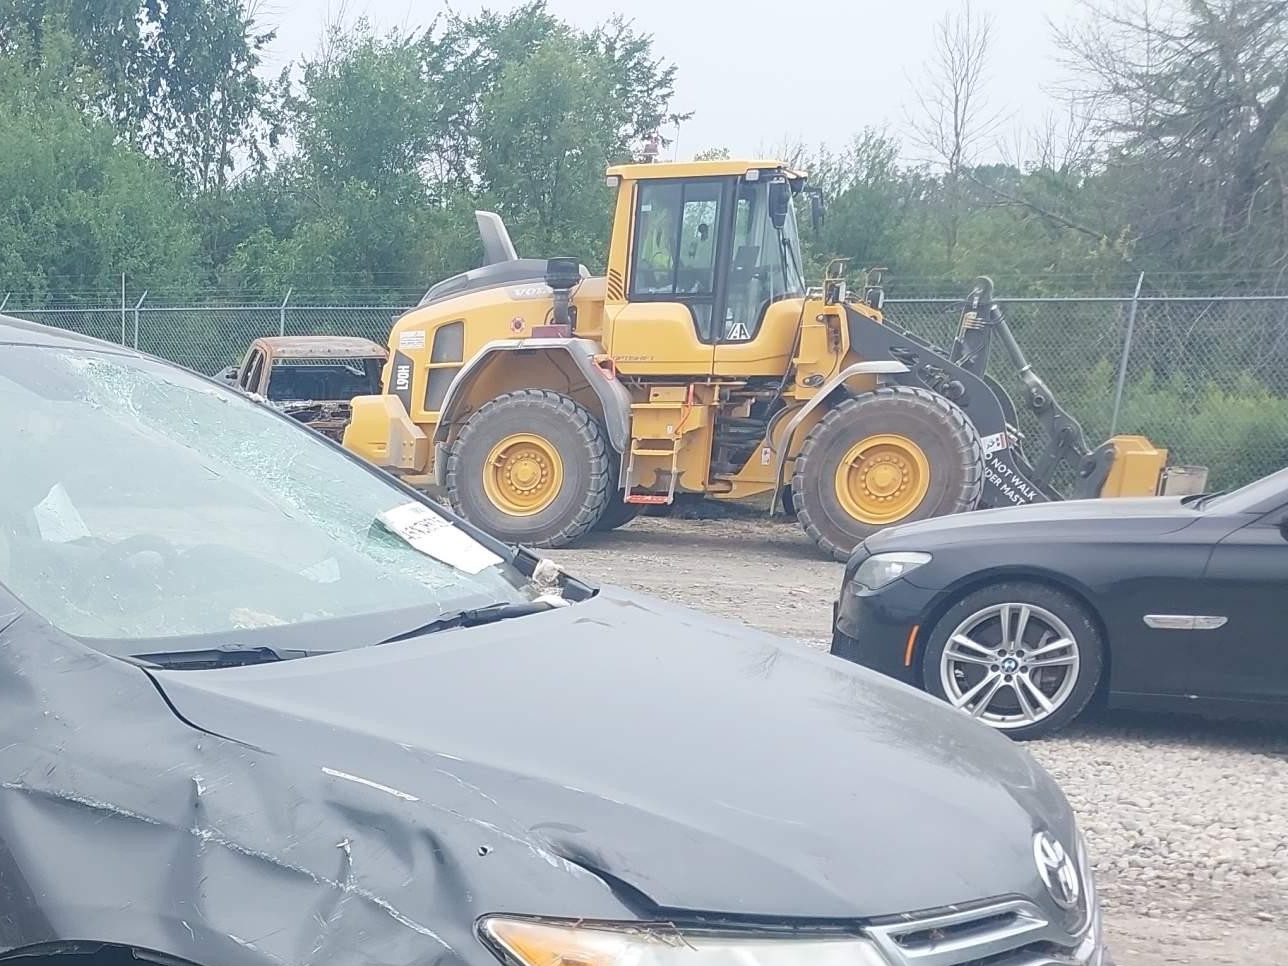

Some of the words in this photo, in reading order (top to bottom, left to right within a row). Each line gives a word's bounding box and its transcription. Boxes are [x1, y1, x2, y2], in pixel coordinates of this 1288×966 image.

[396, 365, 410, 390] L90H
[984, 466, 1002, 487] DER
[1000, 483, 1026, 506] MAST
[991, 458, 1013, 477] NOT
[1011, 475, 1037, 501] WALK
